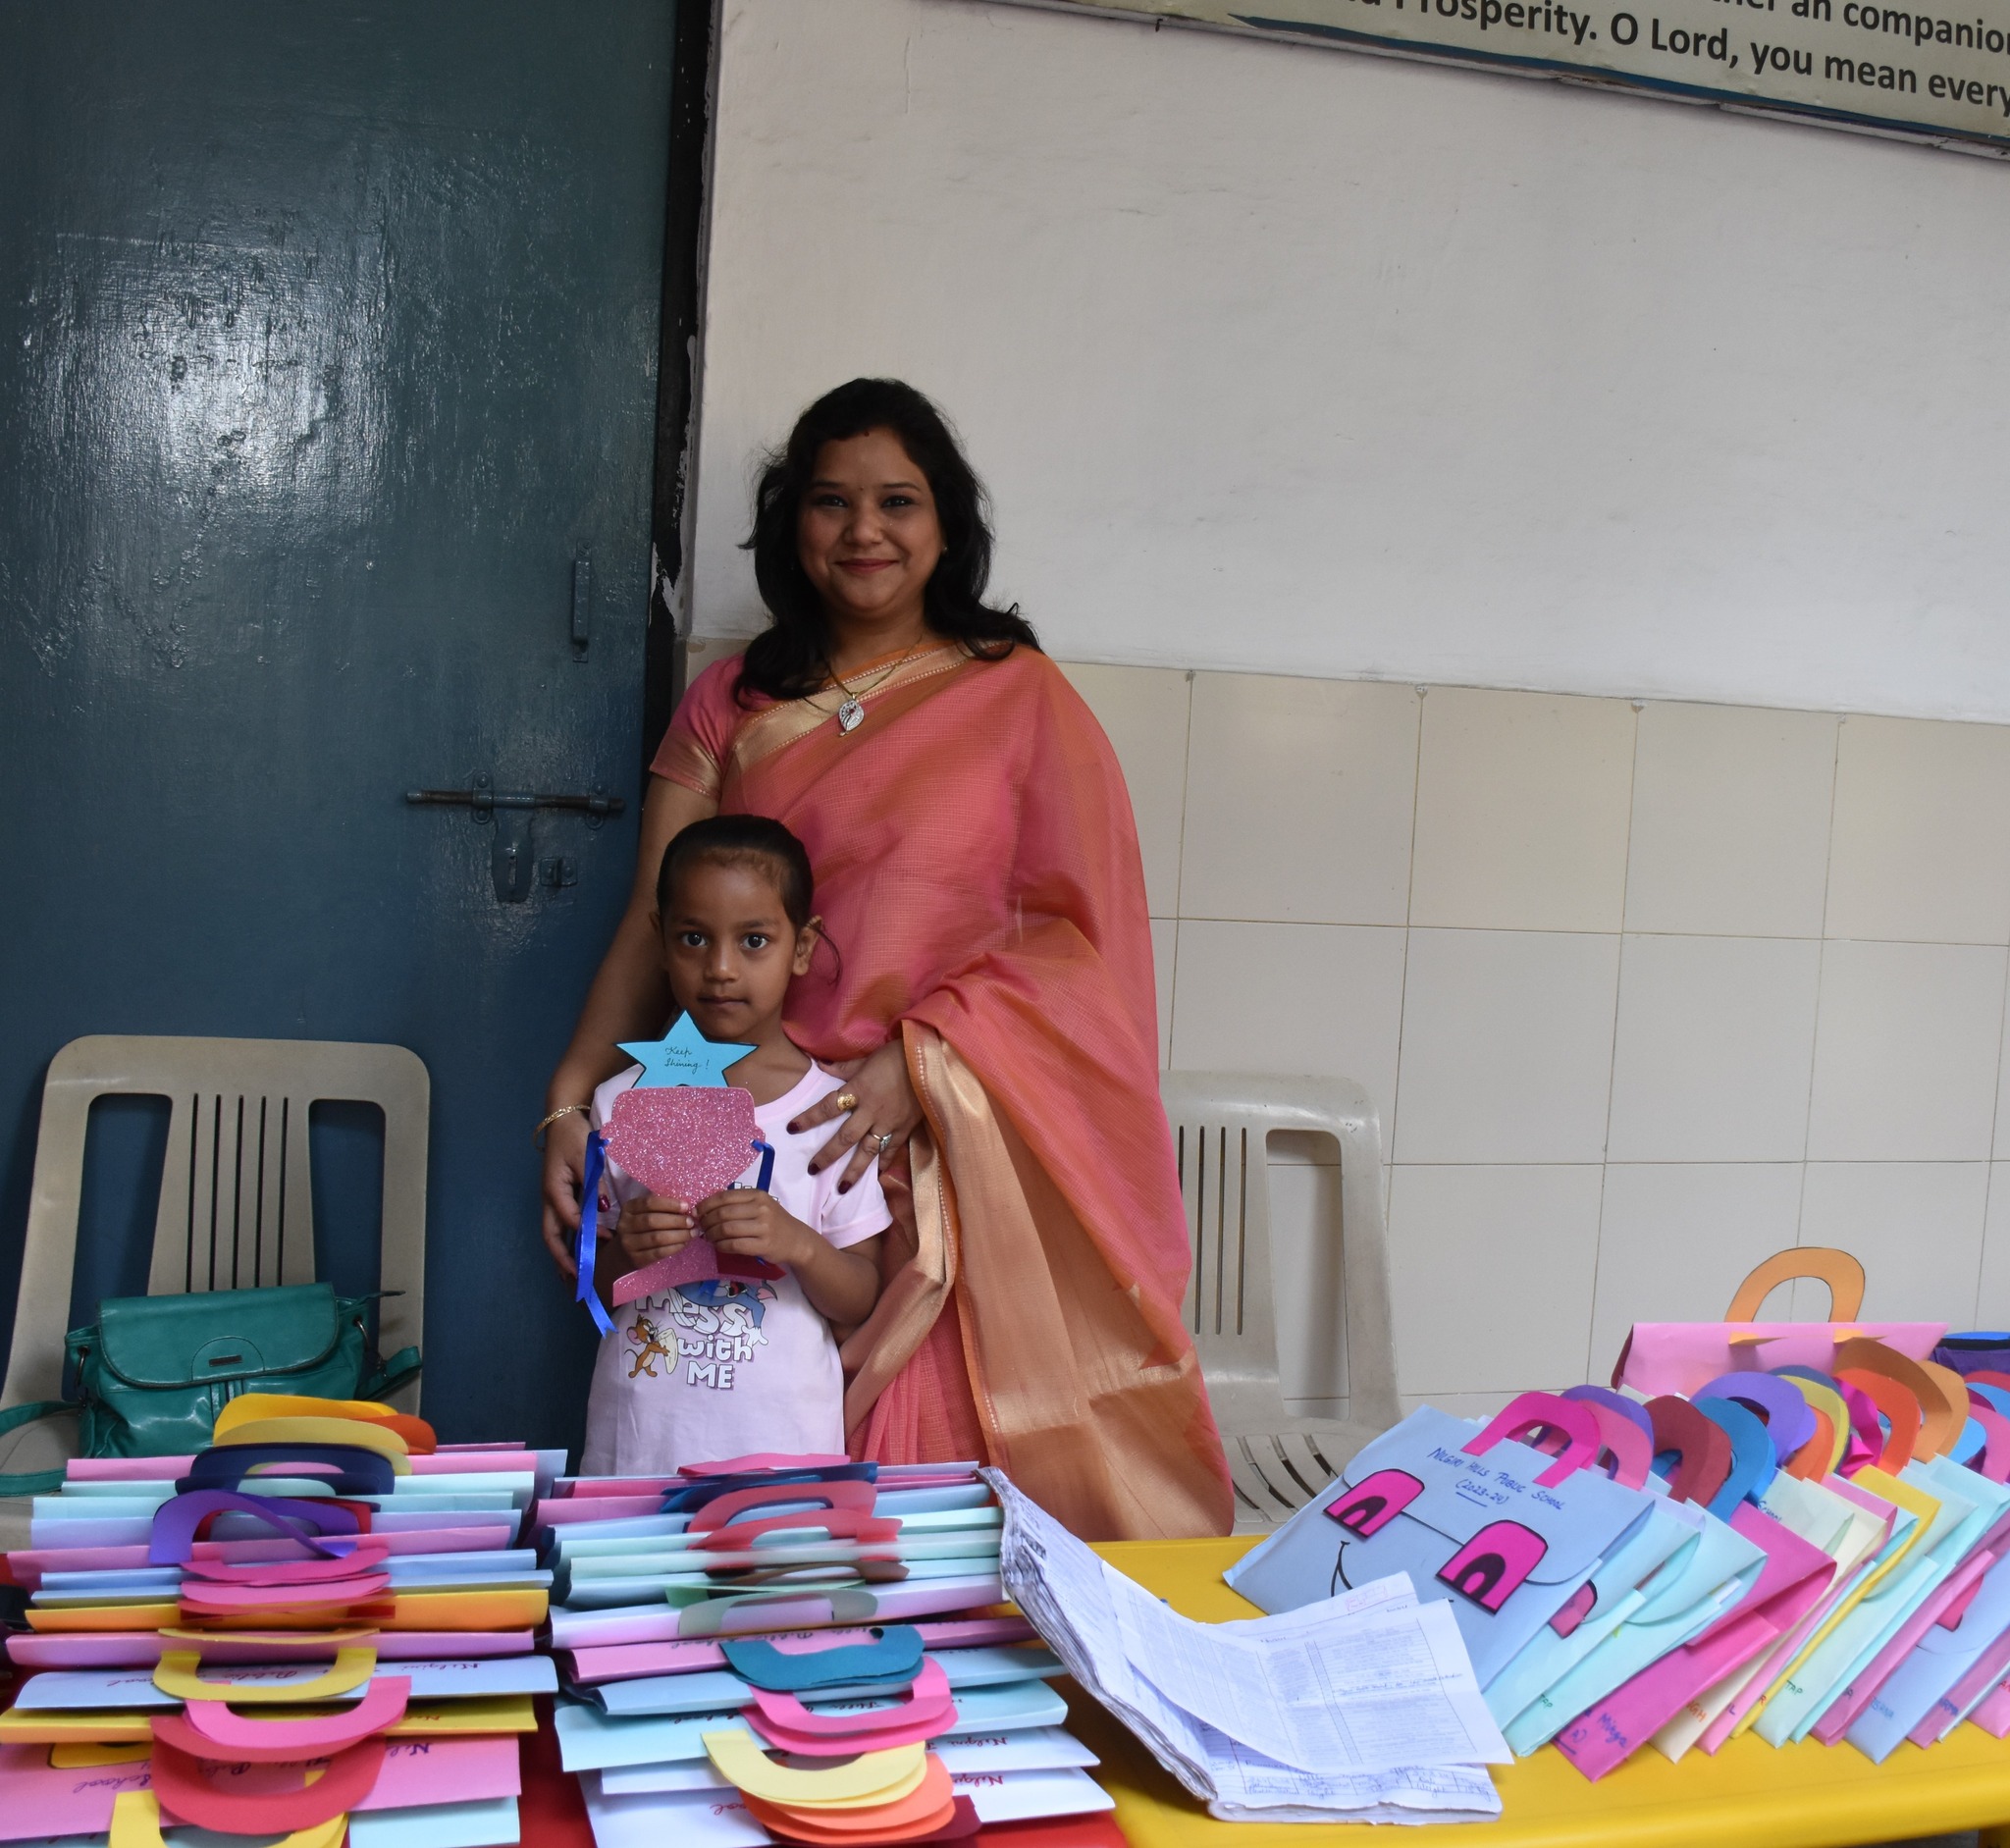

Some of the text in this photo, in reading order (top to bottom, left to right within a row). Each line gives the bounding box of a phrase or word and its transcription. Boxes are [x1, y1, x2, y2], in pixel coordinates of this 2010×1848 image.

[1791, 0, 1831, 22] an
[1396, 0, 1597, 45] osperity.
[1610, 13, 1638, 45] O
[1651, 19, 1739, 69] Lord,
[1750, 41, 1813, 76] you
[1825, 55, 1917, 94] mean
[664, 1046, 693, 1058] Keep
[677, 1335, 754, 1362] with
[687, 1360, 735, 1390] ME
[1427, 1447, 1465, 1468] NILGIRI
[1494, 1471, 1527, 1493] PUBLIC
[1531, 1490, 1566, 1510] SCHOOL
[1455, 1478, 1509, 1505] (2023-24)
